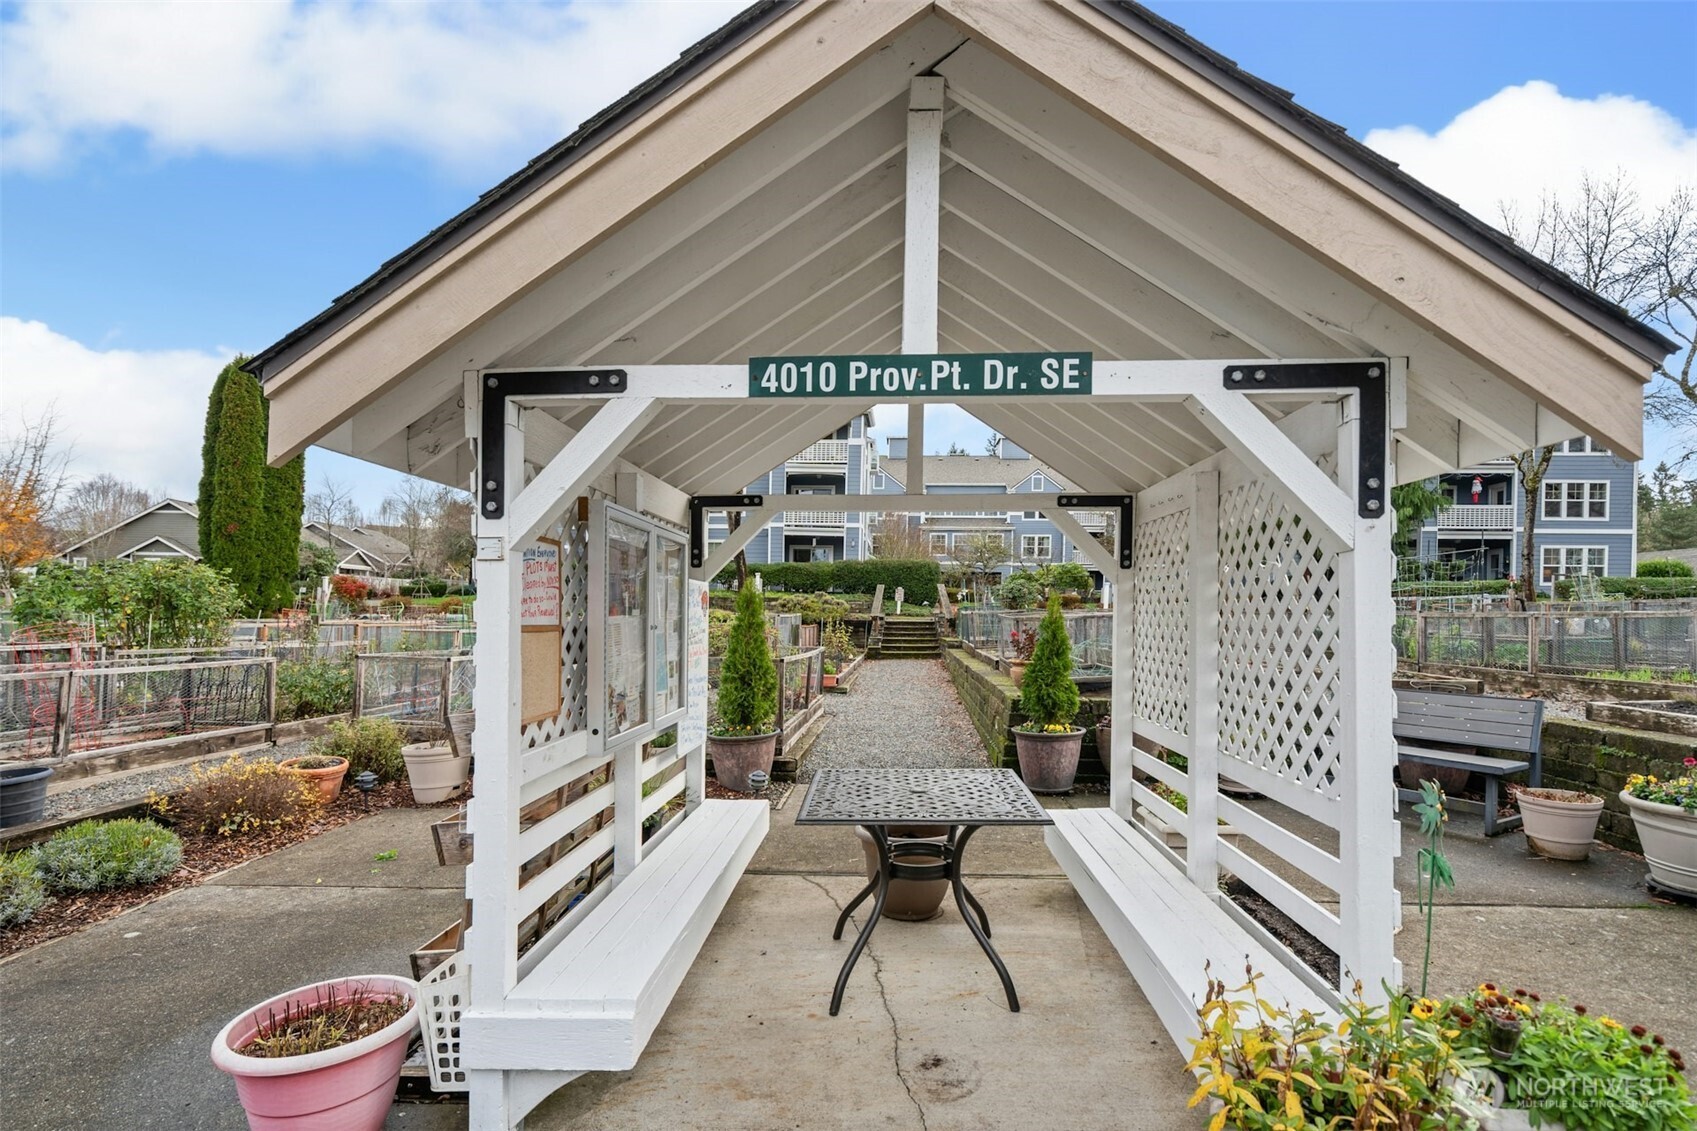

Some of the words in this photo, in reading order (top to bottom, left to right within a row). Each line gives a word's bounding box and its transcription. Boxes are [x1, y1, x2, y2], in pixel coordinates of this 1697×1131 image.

[761, 362, 836, 392] 4010
[983, 360, 1027, 390] Dr.
[1040, 358, 1080, 389] SE
[526, 561, 543, 575] PLOTS
